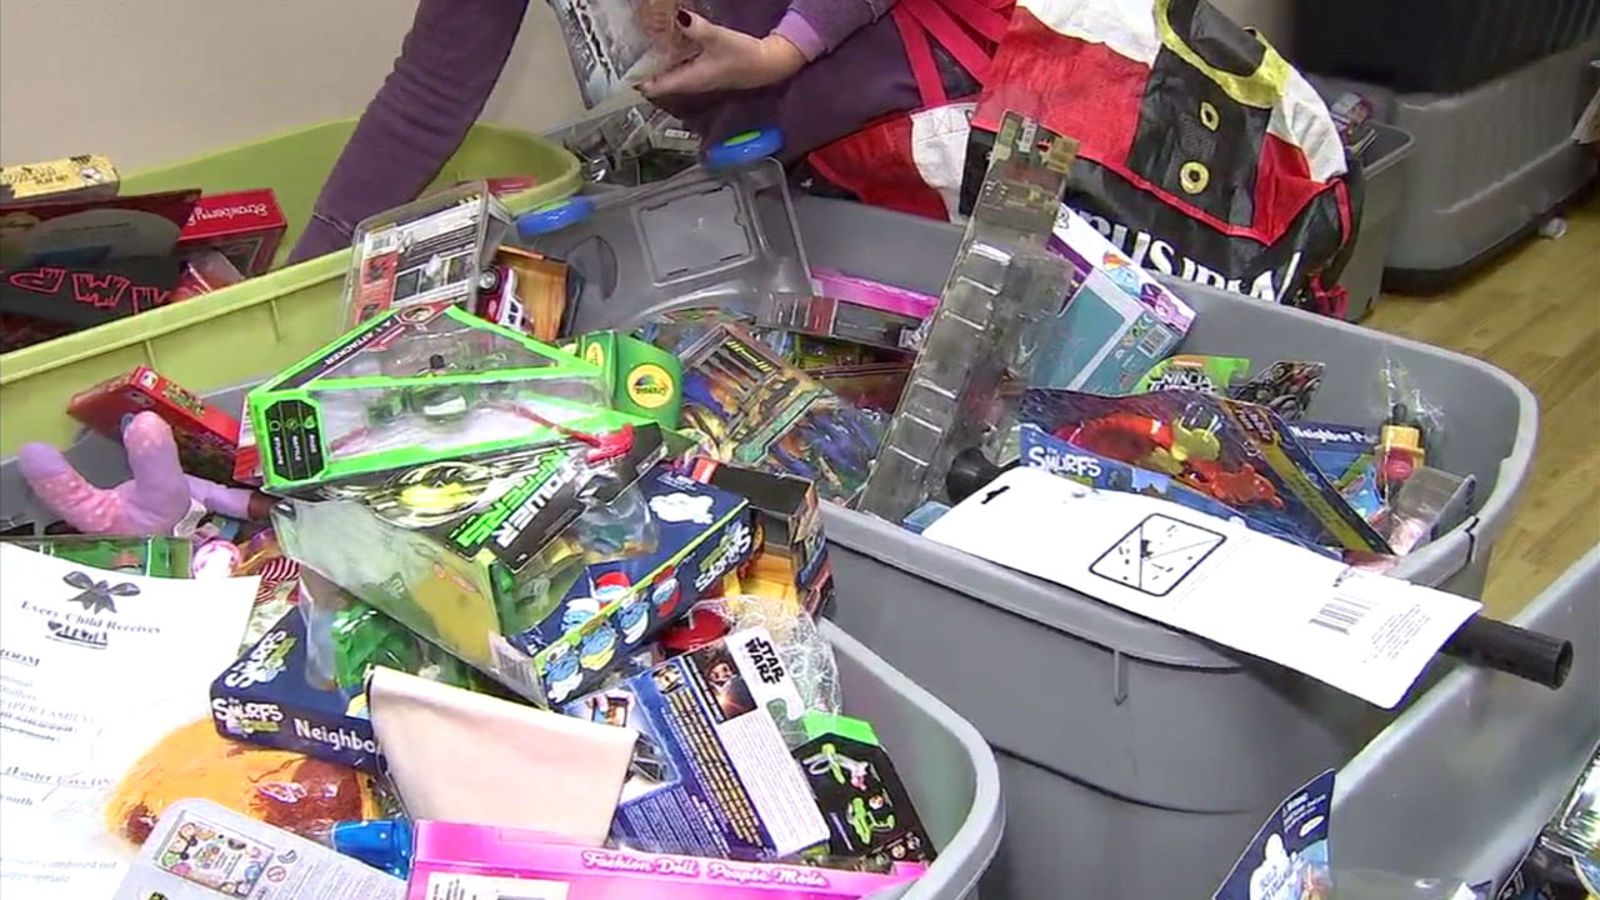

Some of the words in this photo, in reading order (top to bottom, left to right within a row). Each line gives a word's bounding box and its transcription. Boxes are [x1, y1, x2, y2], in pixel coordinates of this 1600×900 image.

[1161, 372, 1212, 387] NINJA
[1028, 446, 1102, 477] SMURFS
[491, 465, 578, 548] POWER
[21, 600, 58, 618] Every
[65, 613, 104, 628] Child
[106, 620, 161, 634] Receives
[744, 638, 776, 685] WARS
[755, 636, 785, 683] STAR
[212, 697, 284, 722] SMURFS
[293, 717, 378, 753] Neighbo
[582, 850, 655, 873] Fashion
[656, 857, 700, 877] Doll
[771, 868, 831, 888] Mode
